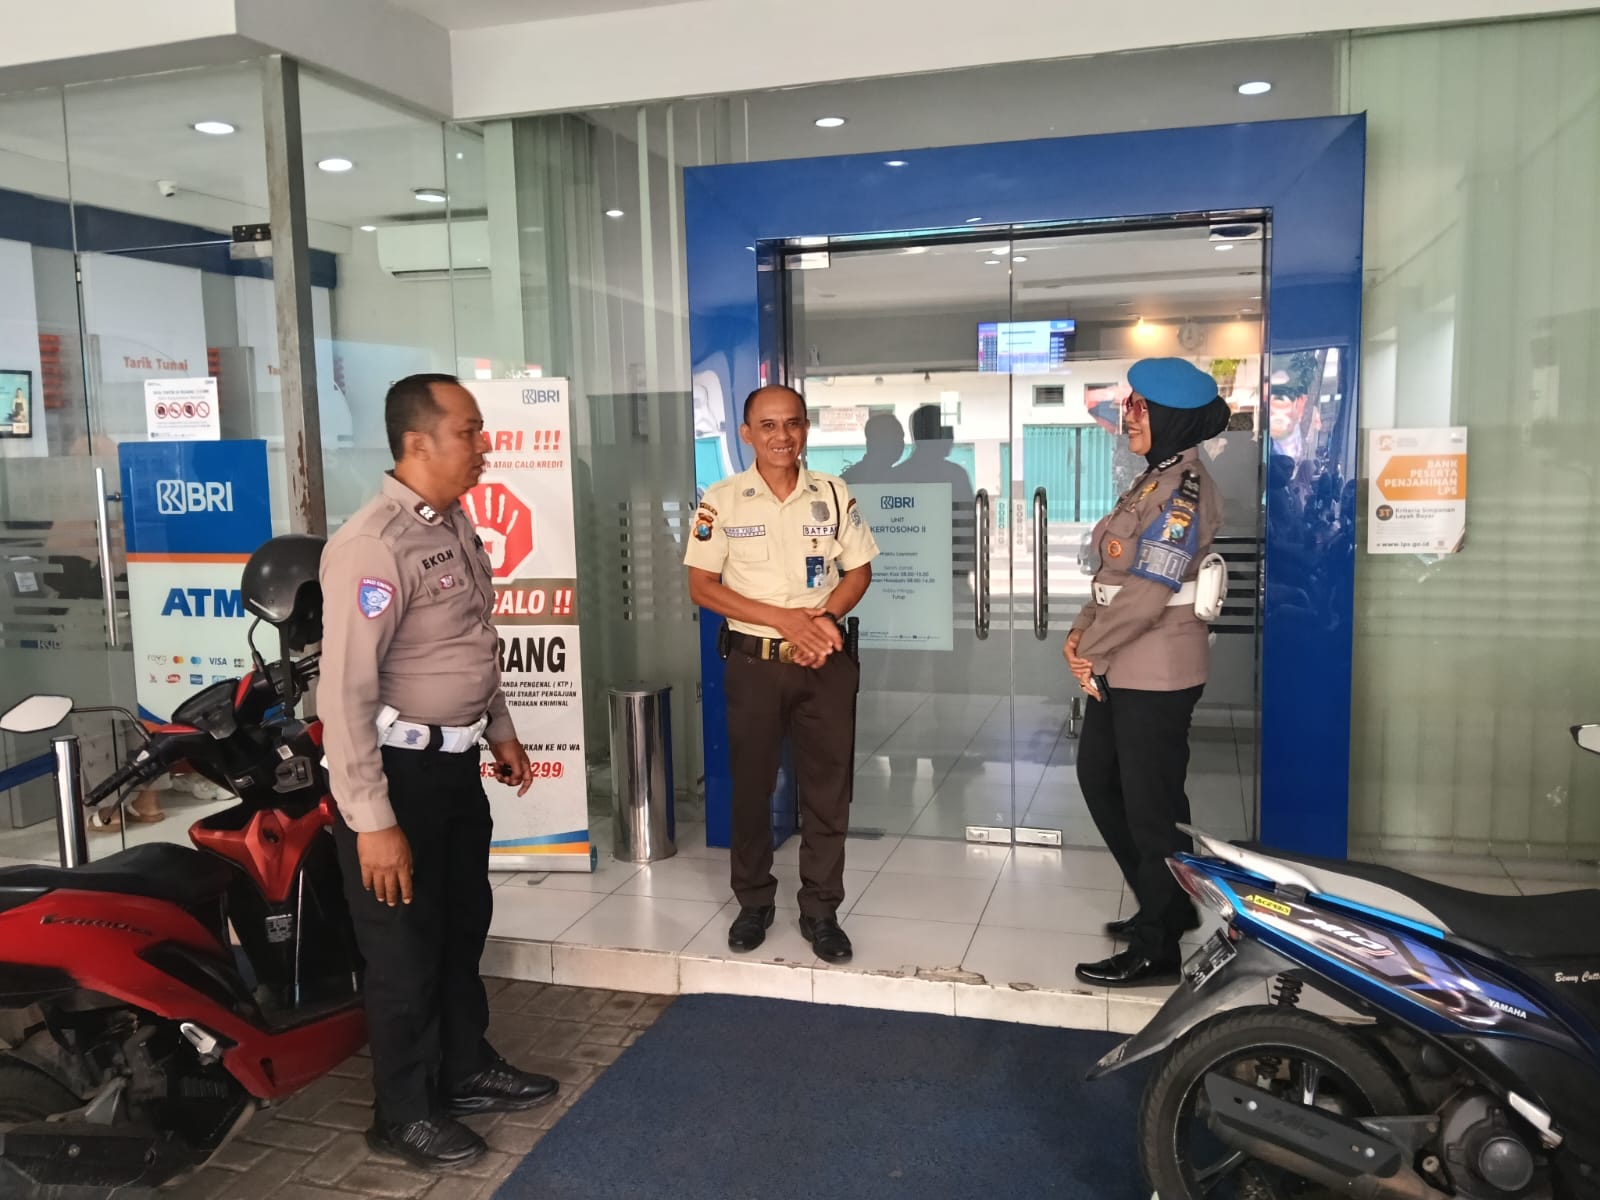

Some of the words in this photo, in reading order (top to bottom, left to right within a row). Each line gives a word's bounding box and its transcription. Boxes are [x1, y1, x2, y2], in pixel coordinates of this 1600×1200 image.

[123, 355, 152, 369] Tarik
[156, 357, 189, 372] Tunai
[534, 430, 560, 451] !!!
[493, 460, 512, 469] ATAU
[515, 460, 535, 469] CALO
[537, 460, 563, 469] KREDIT
[1427, 458, 1458, 469] BANK
[1410, 468, 1458, 478] PESERTA
[1384, 477, 1458, 489] PENJAMINAN
[186, 480, 234, 513] BRI
[804, 526, 838, 536] SATPA
[161, 588, 246, 618] ATM
[553, 589, 573, 614] !!
[209, 657, 228, 666] VISA
[541, 690, 577, 698] PENGAJUAN
[545, 744, 555, 752] KE
[556, 744, 567, 752] NO
[569, 744, 580, 752] WA
[1488, 997, 1527, 1020] YAMAHA
